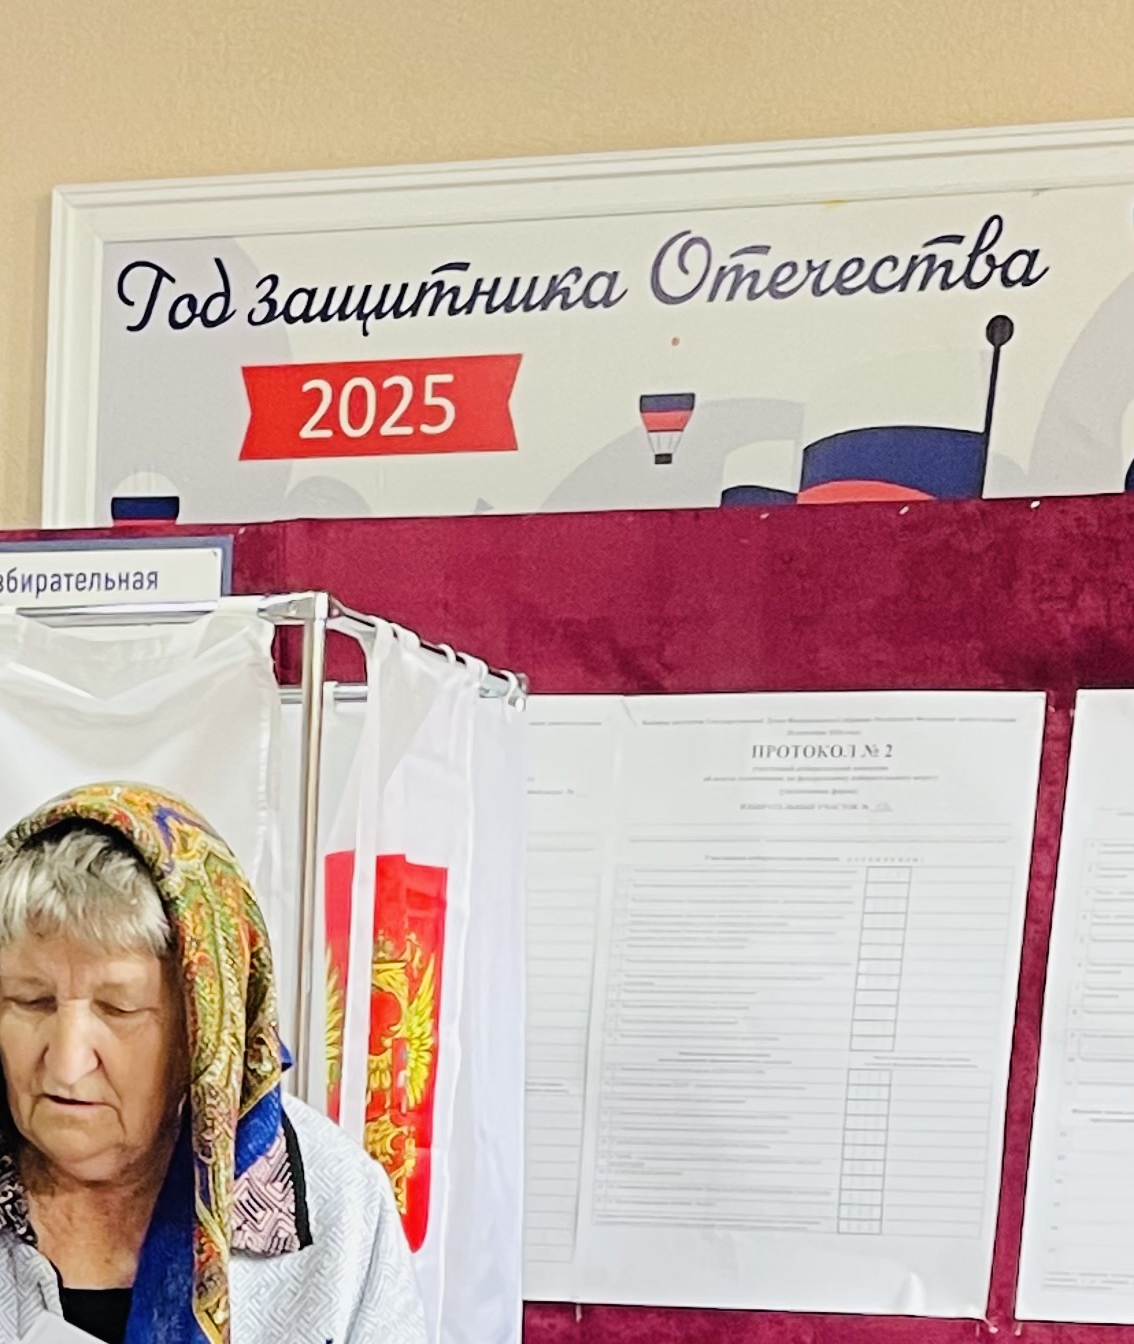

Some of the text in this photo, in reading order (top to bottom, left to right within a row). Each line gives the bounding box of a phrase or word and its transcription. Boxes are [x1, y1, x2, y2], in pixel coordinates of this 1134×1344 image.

[116, 214, 1050, 338] Год защитника Отечества
[298, 372, 457, 440] 2025
[751, 743, 856, 759] ПРОТОКОЛ
[884, 743, 893, 758] 2
